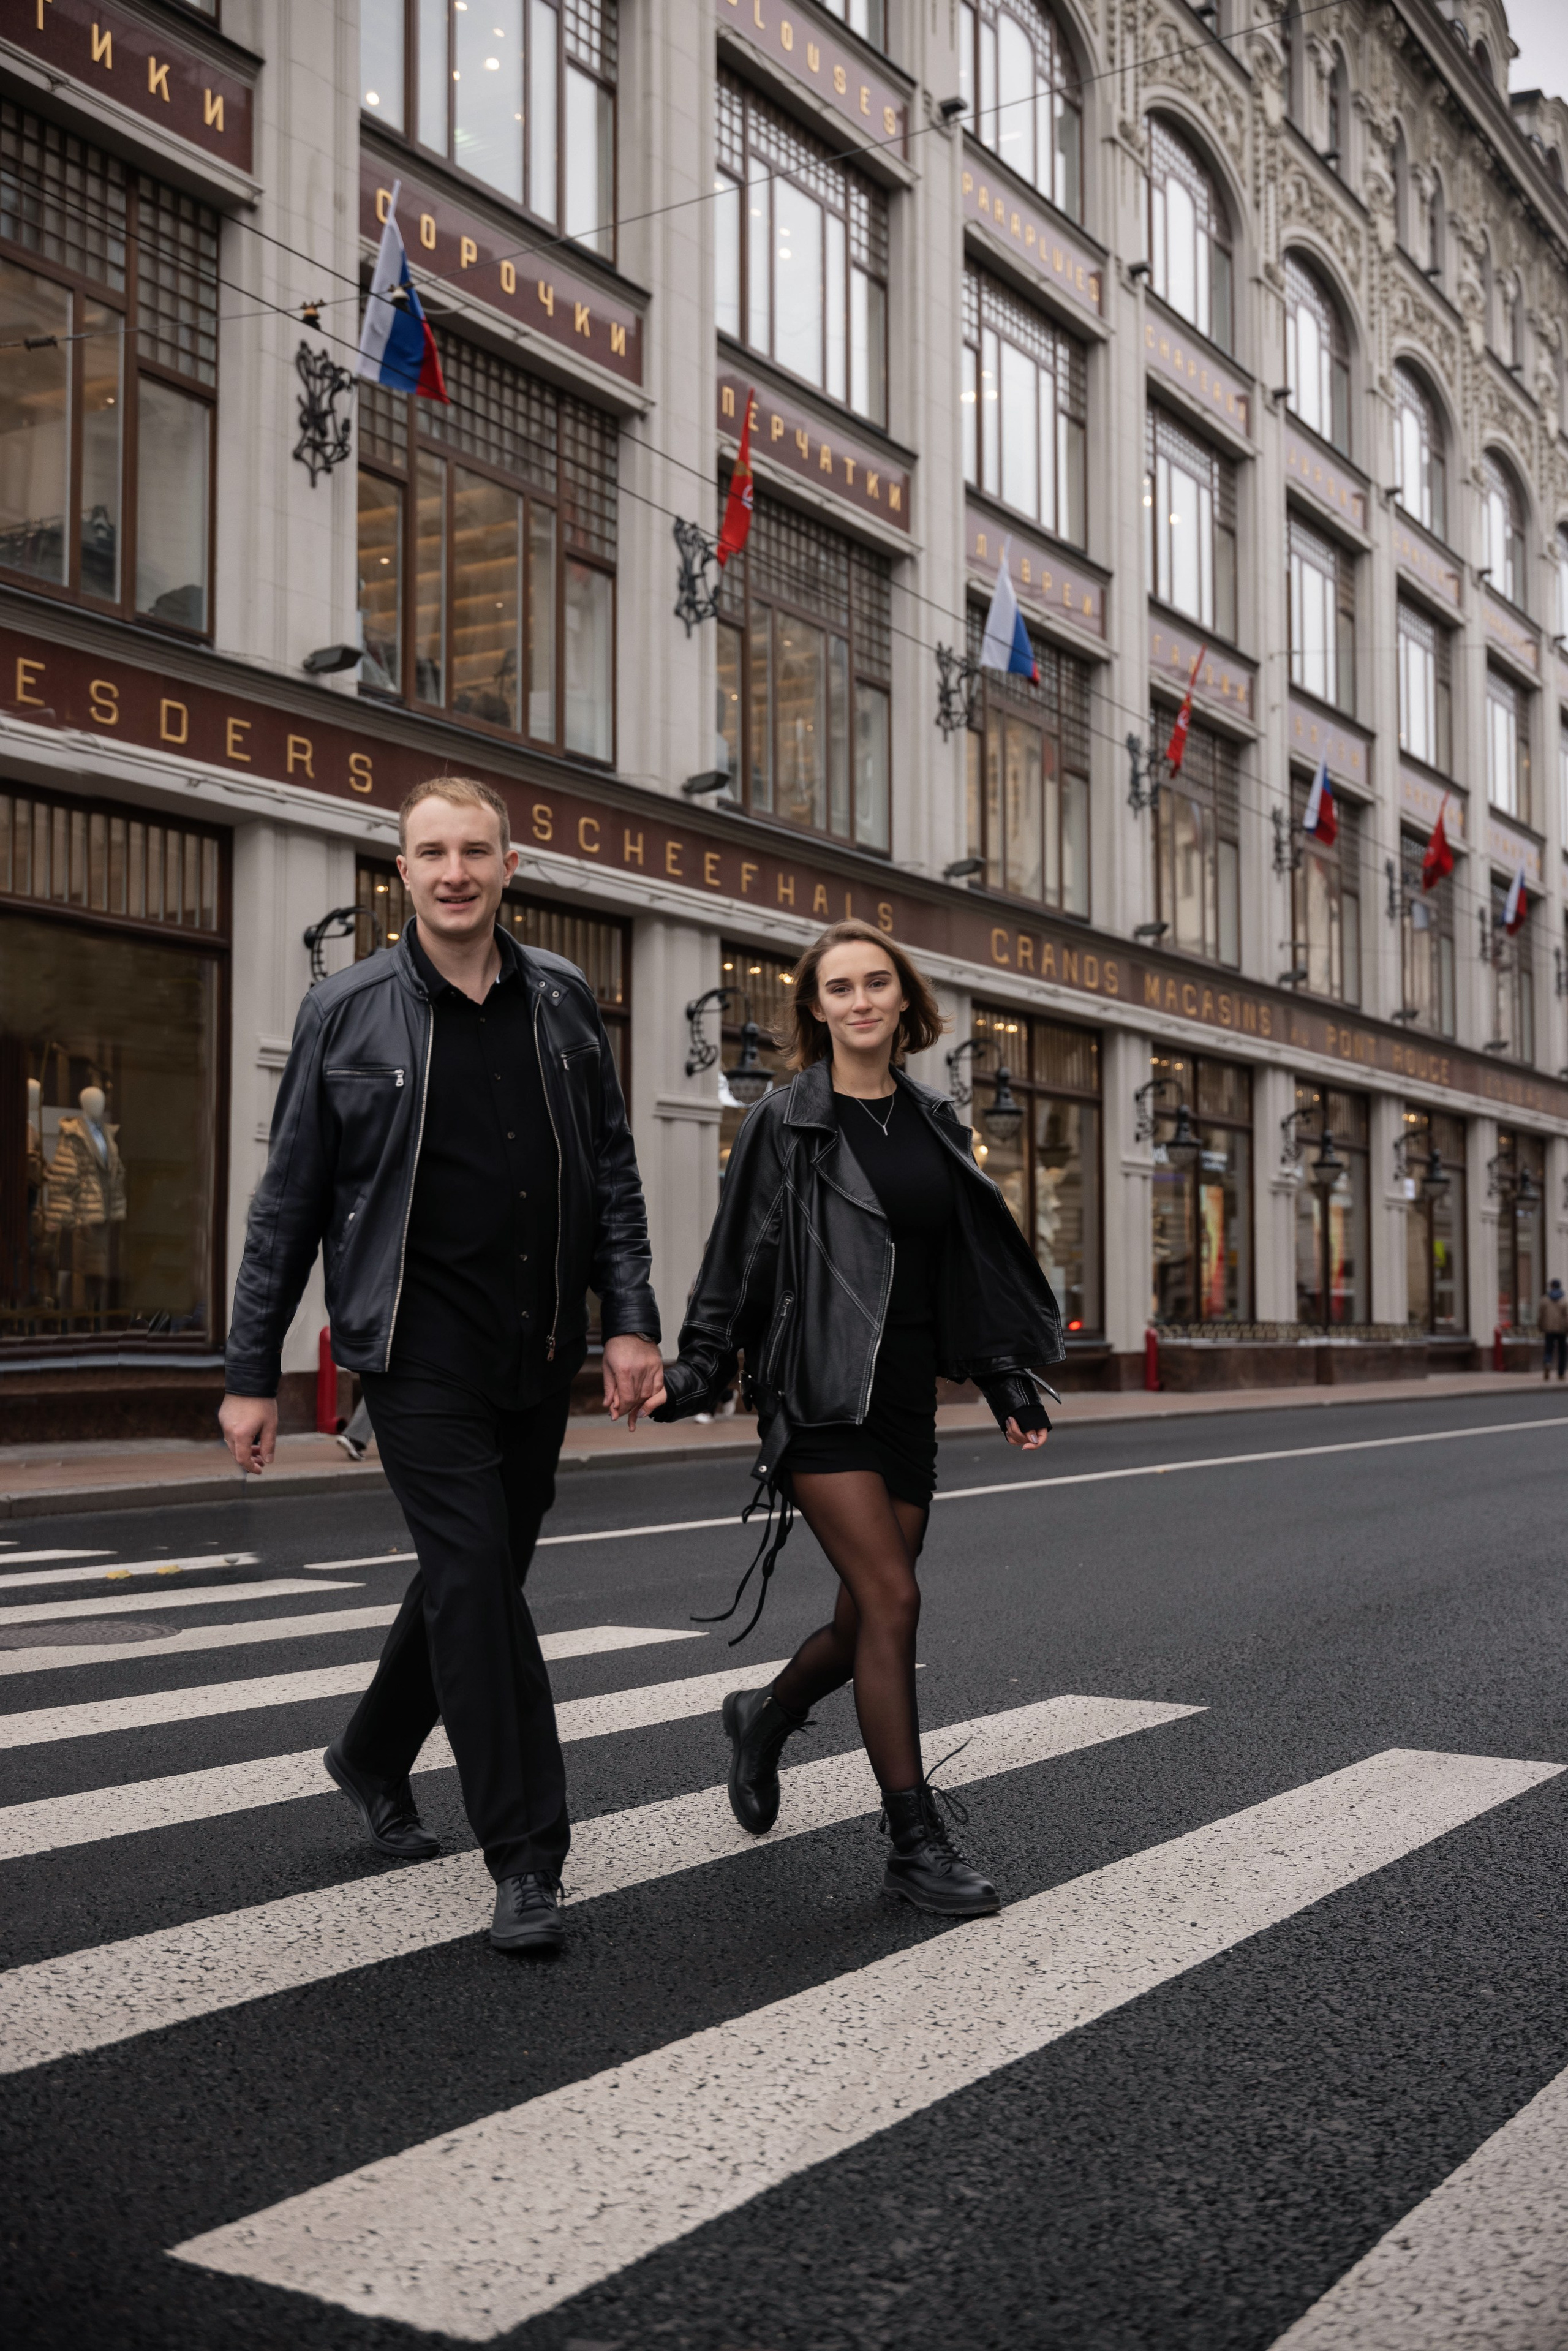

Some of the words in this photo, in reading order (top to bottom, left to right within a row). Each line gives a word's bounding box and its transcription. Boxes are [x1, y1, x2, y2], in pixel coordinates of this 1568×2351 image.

[726, 0, 895, 135] LOUSES
[375, 187, 626, 357] СОРОЧКИ
[722, 385, 901, 511] ПЕРЧАТКИ
[16, 657, 373, 794] ESDERS
